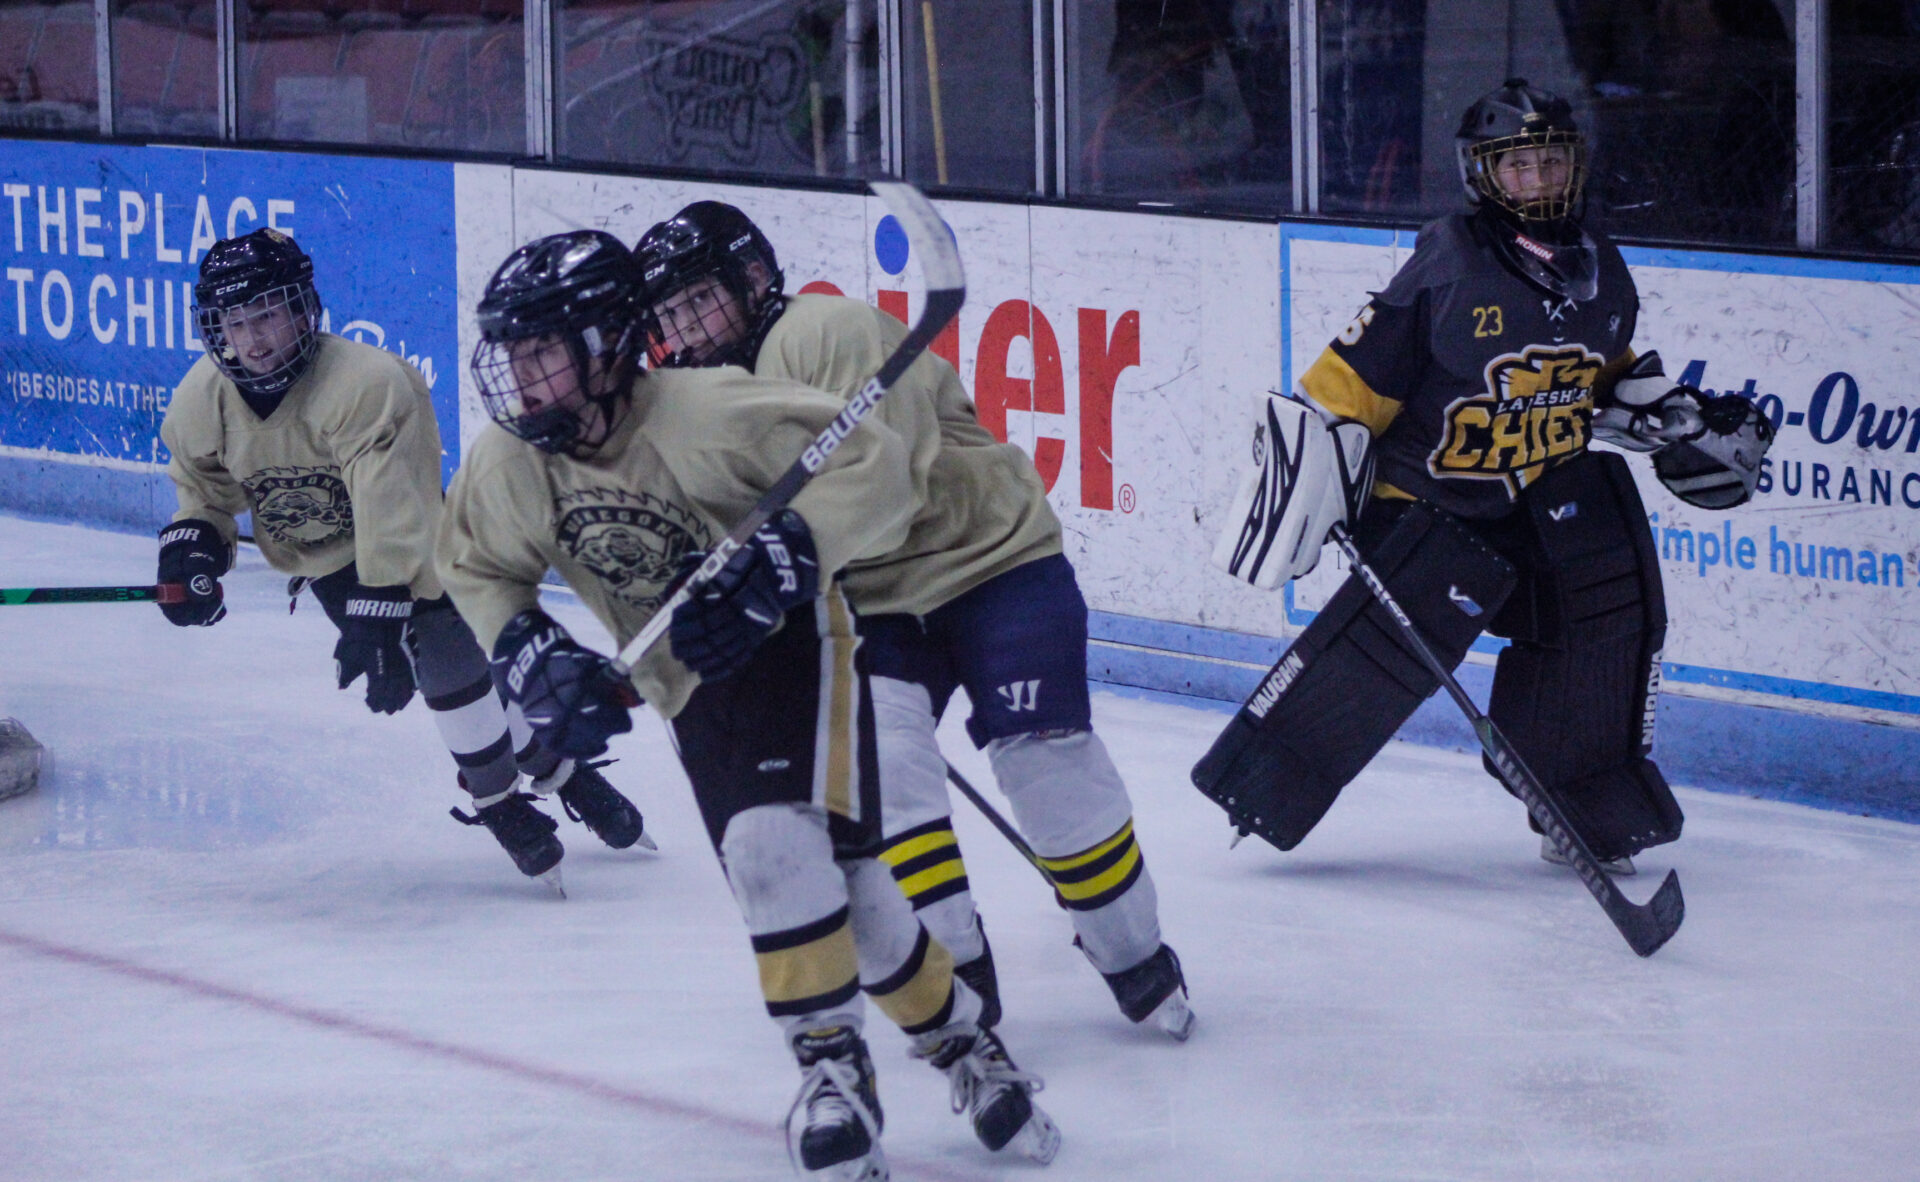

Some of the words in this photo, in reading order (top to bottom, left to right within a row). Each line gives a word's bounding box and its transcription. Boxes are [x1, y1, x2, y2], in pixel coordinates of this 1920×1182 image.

[4, 184, 104, 258] THE
[119, 188, 295, 264] PLACE
[1515, 234, 1554, 260] RONIN
[216, 280, 249, 296] CCM
[645, 263, 666, 281] CM
[7, 267, 74, 341] TO
[89, 274, 206, 352] CHIL
[1473, 305, 1504, 338] 23
[104, 381, 126, 408] AT
[130, 383, 167, 412] THE
[159, 528, 201, 548] RIOR
[756, 524, 797, 593] UER
[1650, 511, 1757, 578] imple
[1769, 525, 1904, 588] human
[507, 626, 569, 695] BAU
[1248, 650, 1304, 719] VAUGHN
